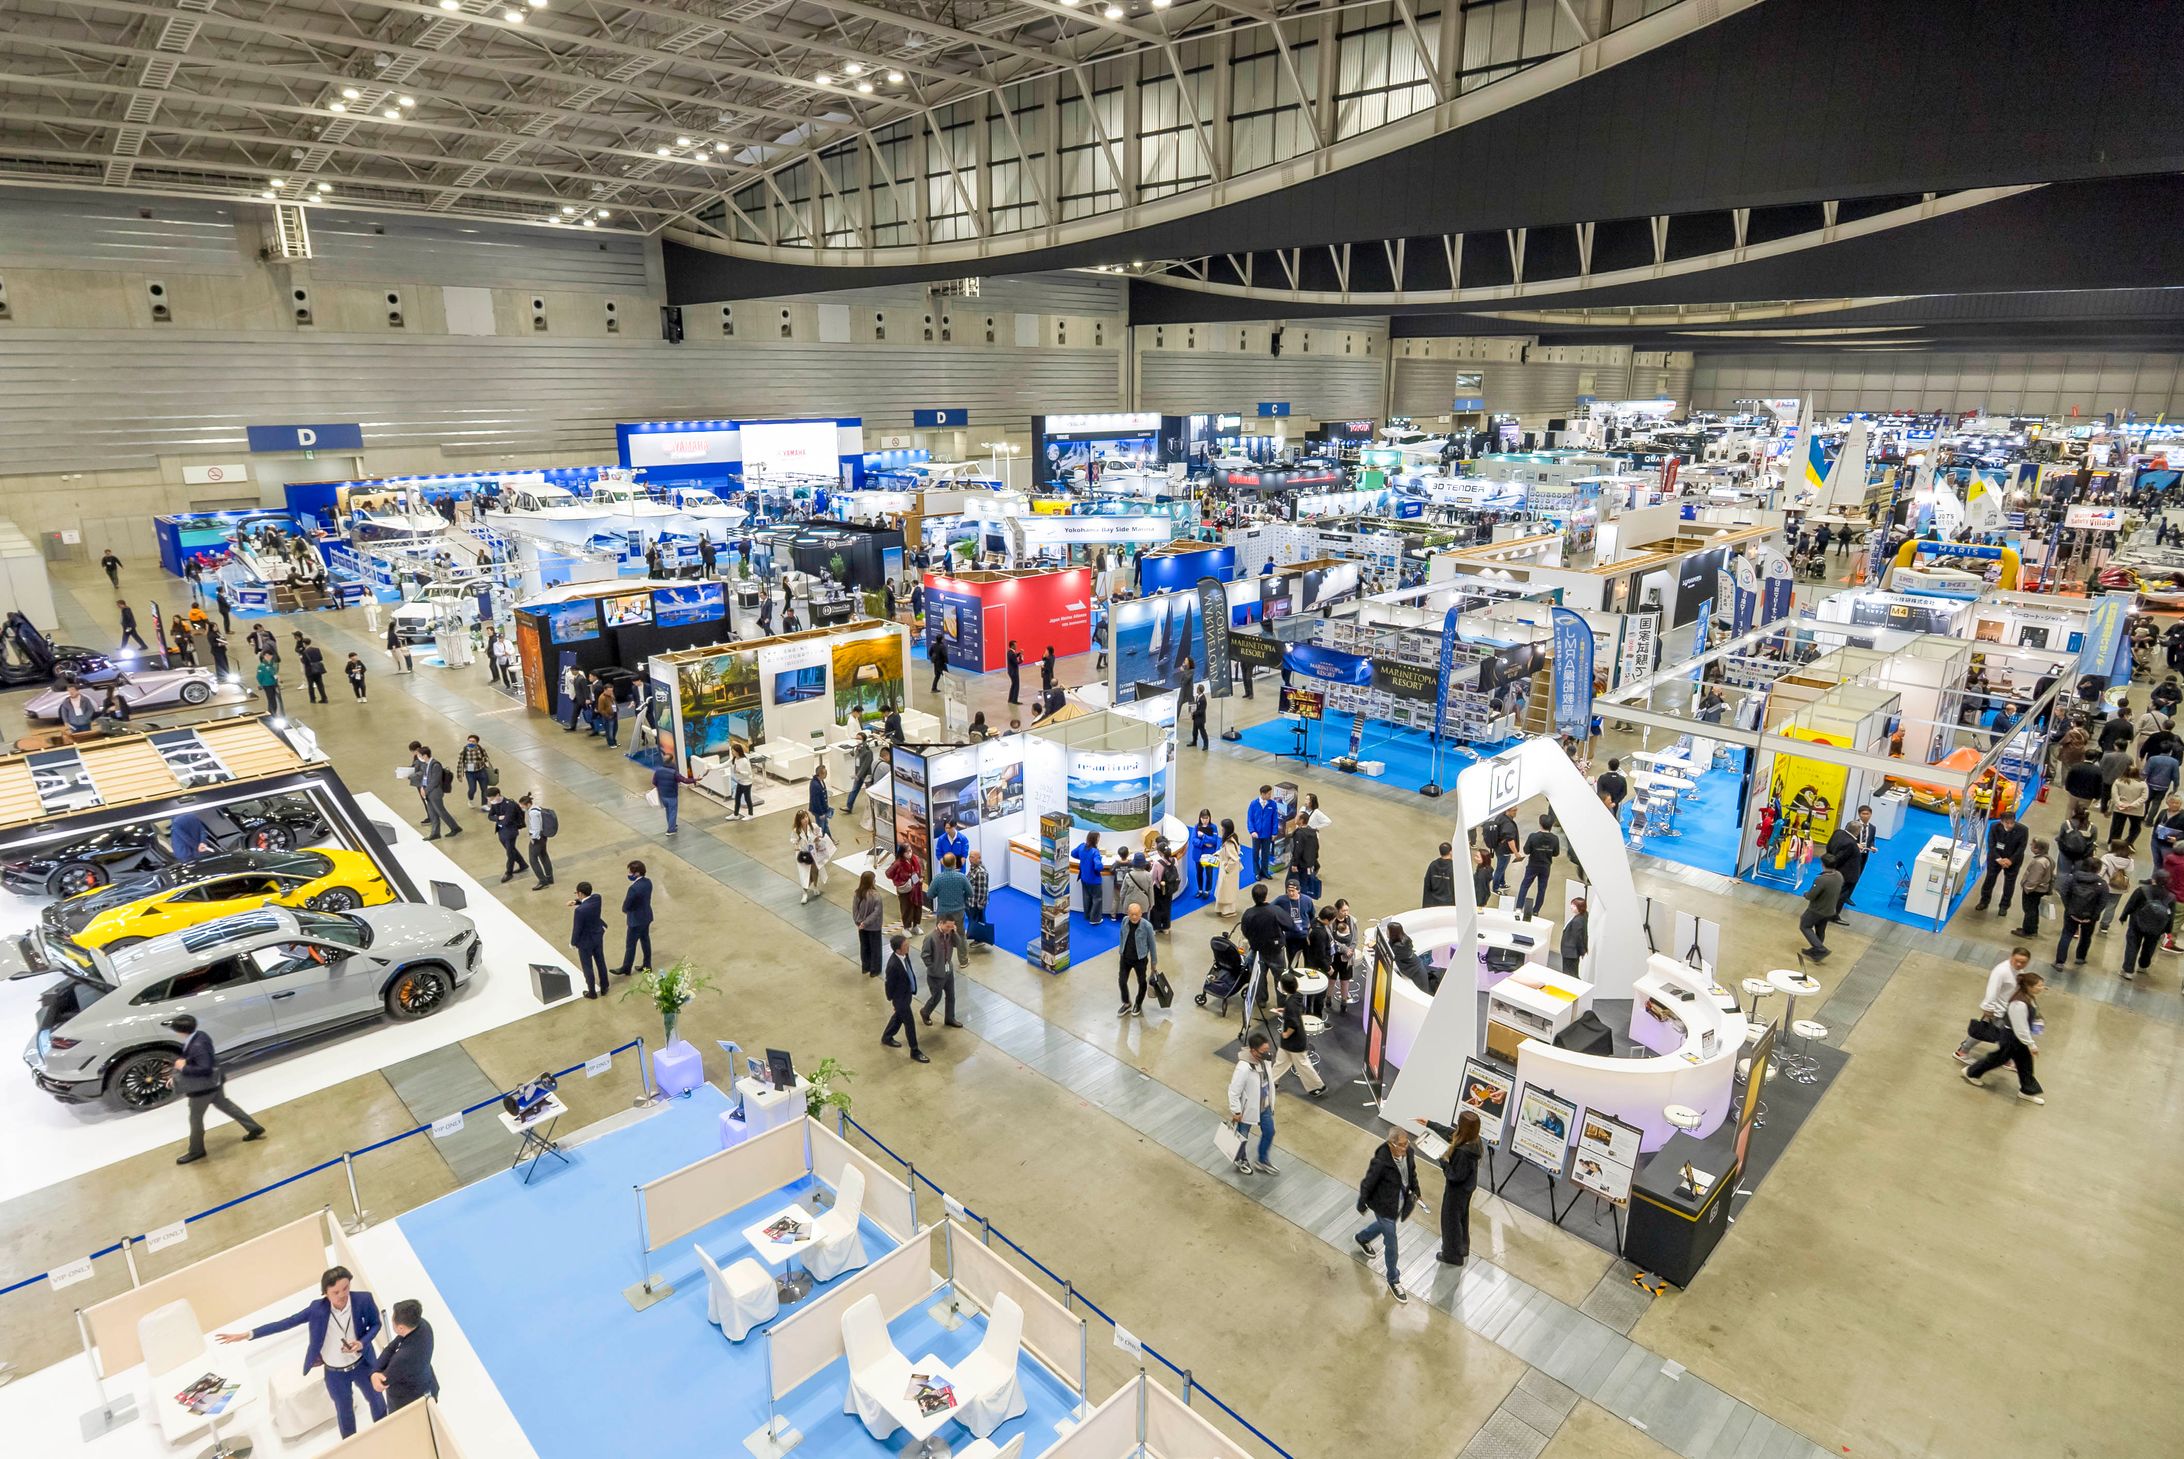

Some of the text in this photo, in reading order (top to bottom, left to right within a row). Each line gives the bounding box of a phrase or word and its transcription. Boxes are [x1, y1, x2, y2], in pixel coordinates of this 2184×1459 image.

[1271, 404, 1278, 414] C
[937, 411, 946, 424] D
[1350, 424, 1370, 432] TOYOTA
[297, 429, 316, 446] D
[674, 440, 710, 453] YAMAHA
[783, 449, 805, 457] YAMAHA
[1447, 484, 1485, 493] TENDER
[2089, 519, 2116, 528] Village
[1938, 546, 1979, 556] MARIS
[1891, 607, 1907, 615] M4
[1230, 638, 1277, 653] MARINETOPIA
[1240, 647, 1266, 659] RESORT
[1309, 662, 1344, 675] MARINETOPIA
[1316, 669, 1336, 678] RESORT
[1381, 666, 1438, 685] MARINETOPIA
[1392, 677, 1424, 691] RESORT
[1496, 769, 1515, 799] LC
[434, 1119, 462, 1133] VIP ONLY
[148, 1228, 185, 1246] VIP ONLY
[52, 1264, 91, 1284] VIP ONLY
